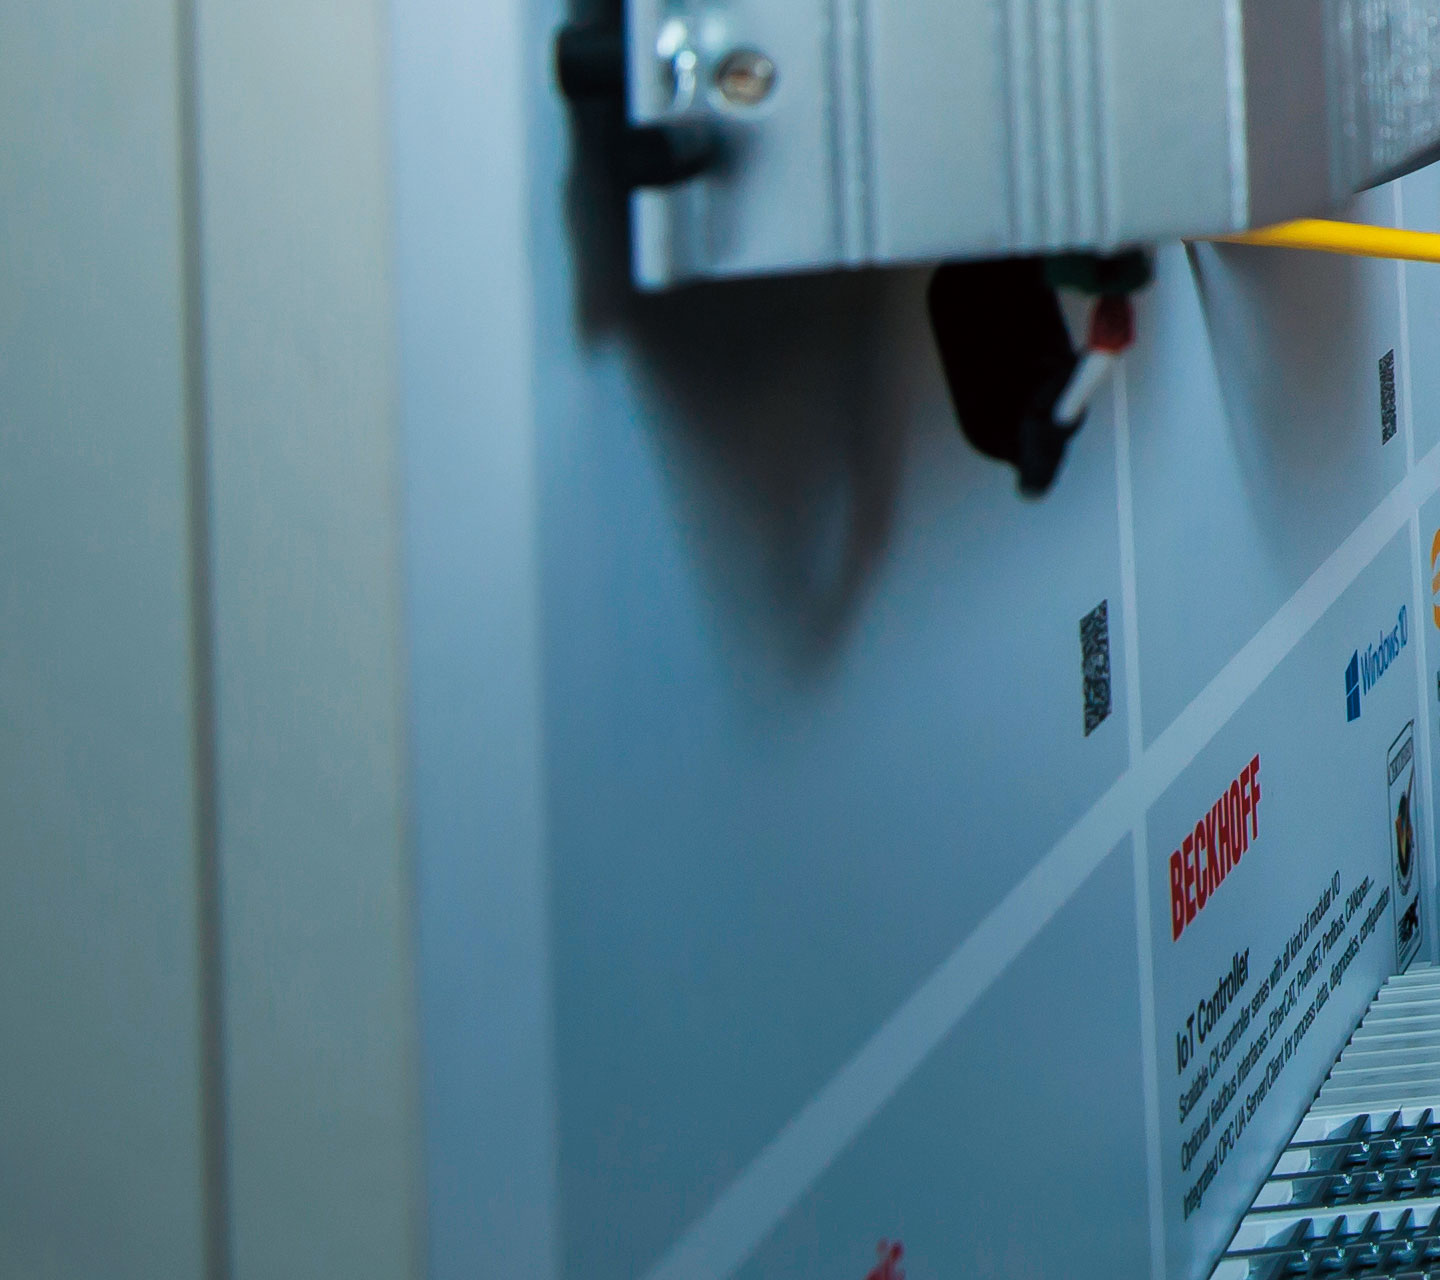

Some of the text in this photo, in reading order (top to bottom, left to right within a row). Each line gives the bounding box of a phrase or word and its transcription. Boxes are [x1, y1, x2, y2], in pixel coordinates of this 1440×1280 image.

[1361, 624, 1400, 697] Windows
[1168, 753, 1262, 943] BECKHOFF
[1175, 946, 1250, 1077] IoT Controller
[1251, 977, 1271, 1019] series
[1269, 955, 1284, 992] with
[1283, 938, 1292, 972] all
[1290, 922, 1304, 961] kind
[1309, 895, 1333, 934] modular
[1183, 1154, 1218, 1223] Integrated
[1217, 1120, 1235, 1168] OPC
[1235, 1106, 1247, 1143] UA
[1284, 1035, 1294, 1065] for
[1293, 1000, 1316, 1056] process
[1359, 885, 1391, 946] configuration
[1181, 1111, 1211, 1173] Optional
